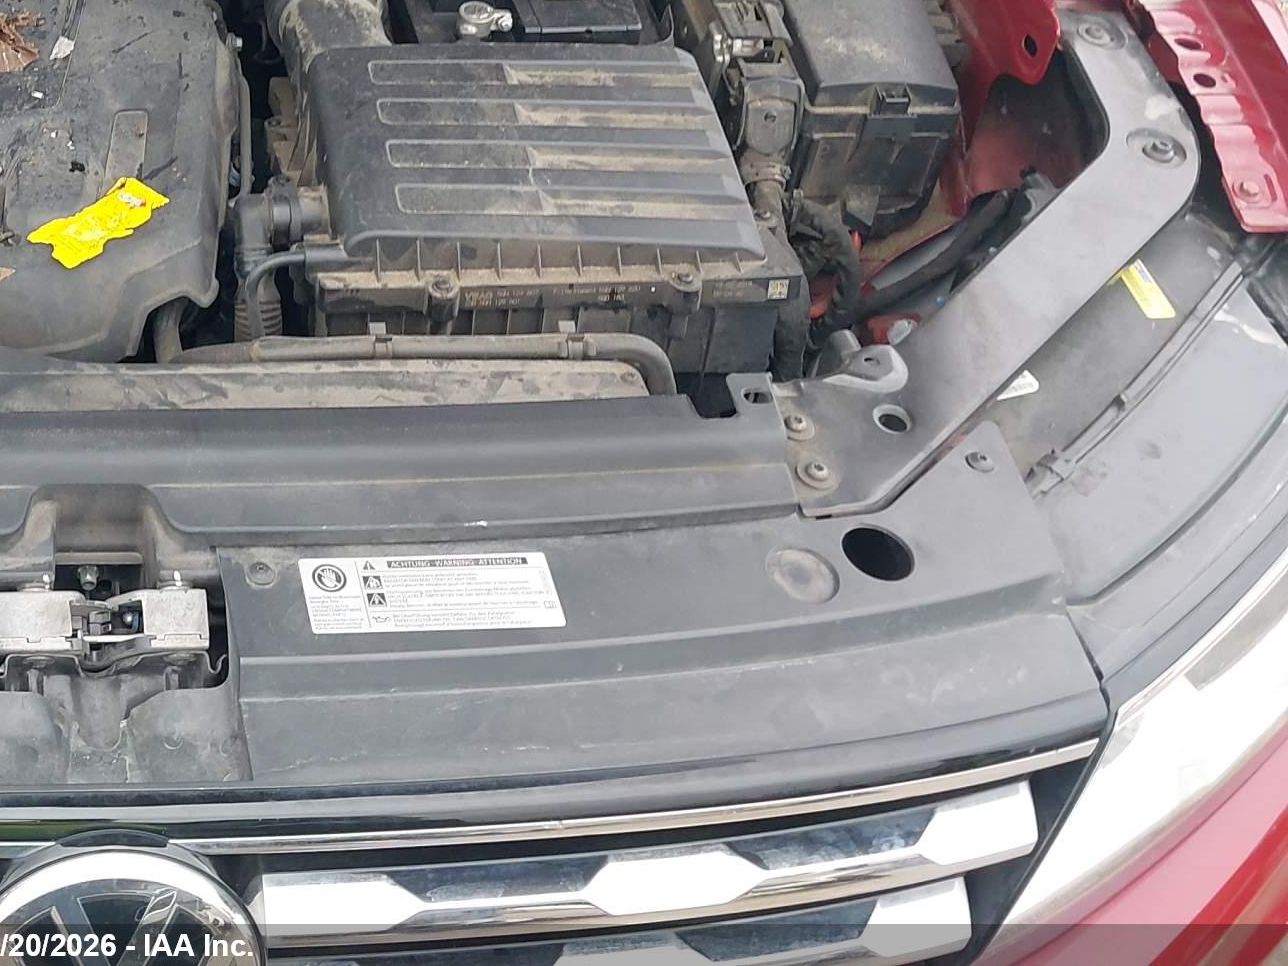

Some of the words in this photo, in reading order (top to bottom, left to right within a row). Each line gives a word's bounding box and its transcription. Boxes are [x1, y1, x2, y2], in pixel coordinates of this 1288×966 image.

[391, 560, 431, 569] ACHTUNG
[434, 559, 473, 568] WARNING
[478, 557, 522, 566] ATTENTION
